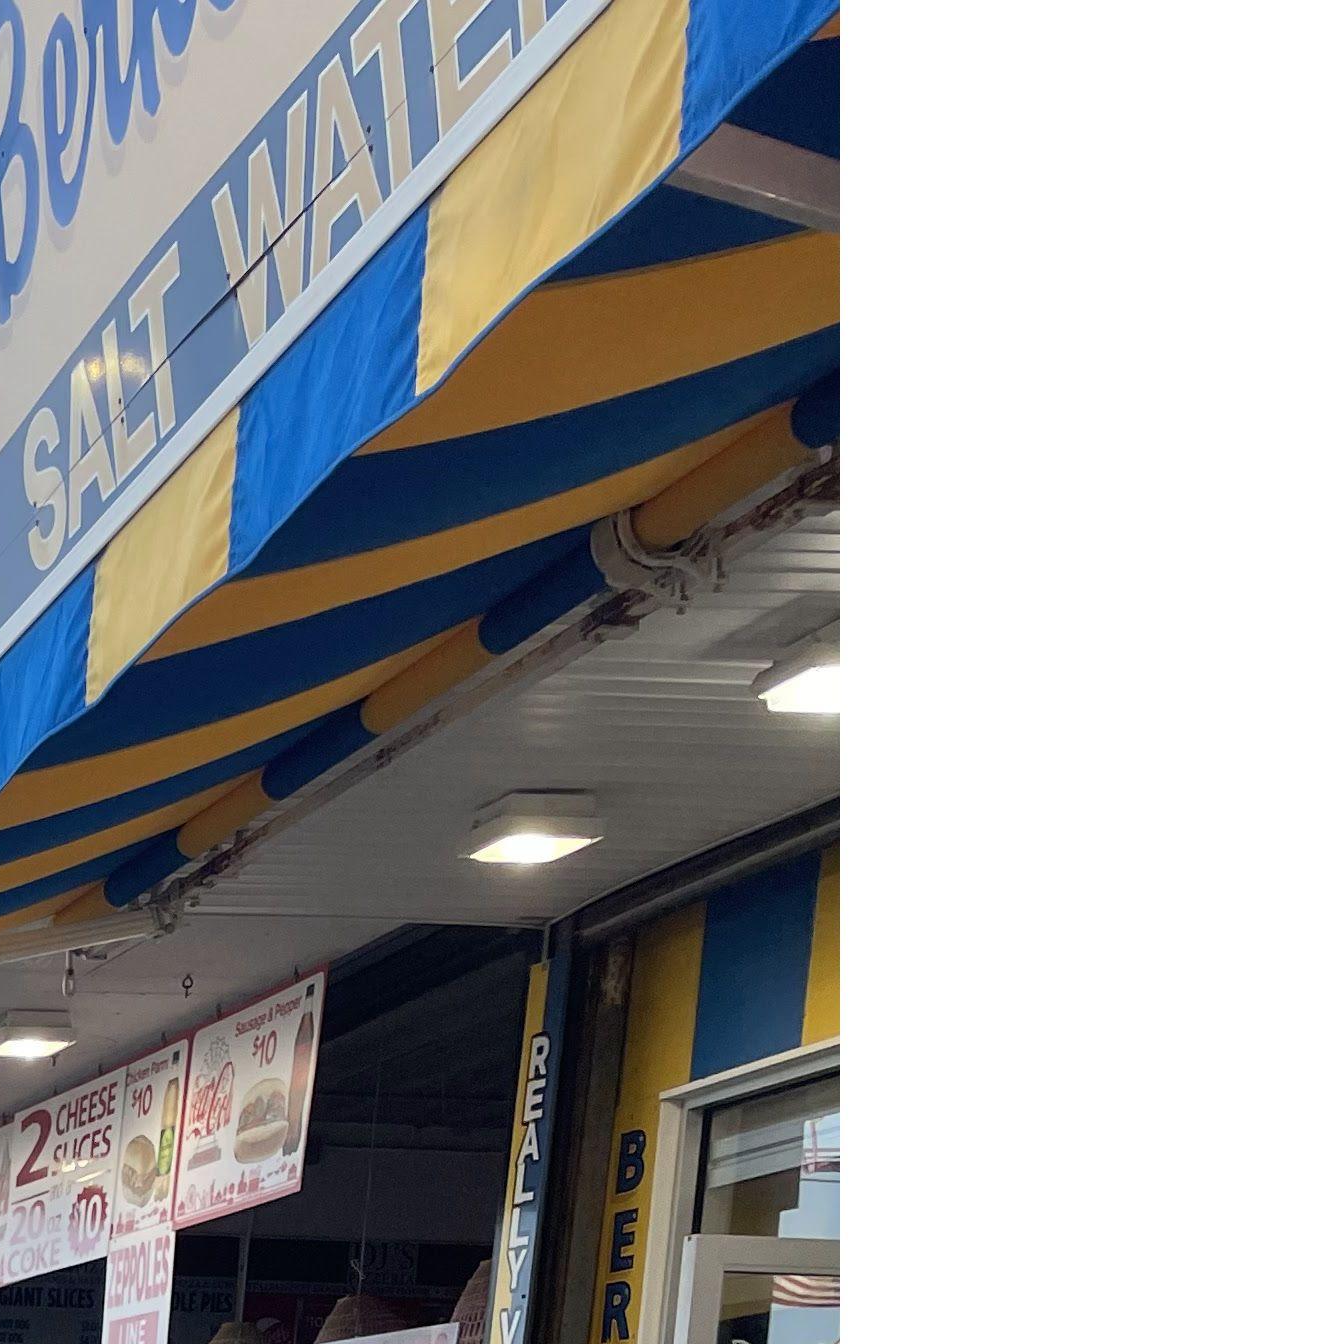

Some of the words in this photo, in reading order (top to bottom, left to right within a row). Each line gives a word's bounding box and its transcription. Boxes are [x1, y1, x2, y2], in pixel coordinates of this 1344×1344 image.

[22, 241, 181, 572] SALT
[211, 0, 552, 350] WATE
[235, 1013, 266, 1038] Sausage
[274, 995, 303, 1018] Pepper
[251, 1029, 278, 1068] $10
[131, 1083, 154, 1119] $10
[15, 1108, 53, 1188] 2
[55, 1081, 119, 1137] CHEESE
[53, 1124, 113, 1177] SLICES
[510, 1034, 551, 1290] REALLY
[11, 1199, 47, 1246] 20
[7, 1239, 63, 1280] COKE
[108, 1234, 171, 1310] ZEPPOLES
[47, 1287, 95, 1309] SLICES
